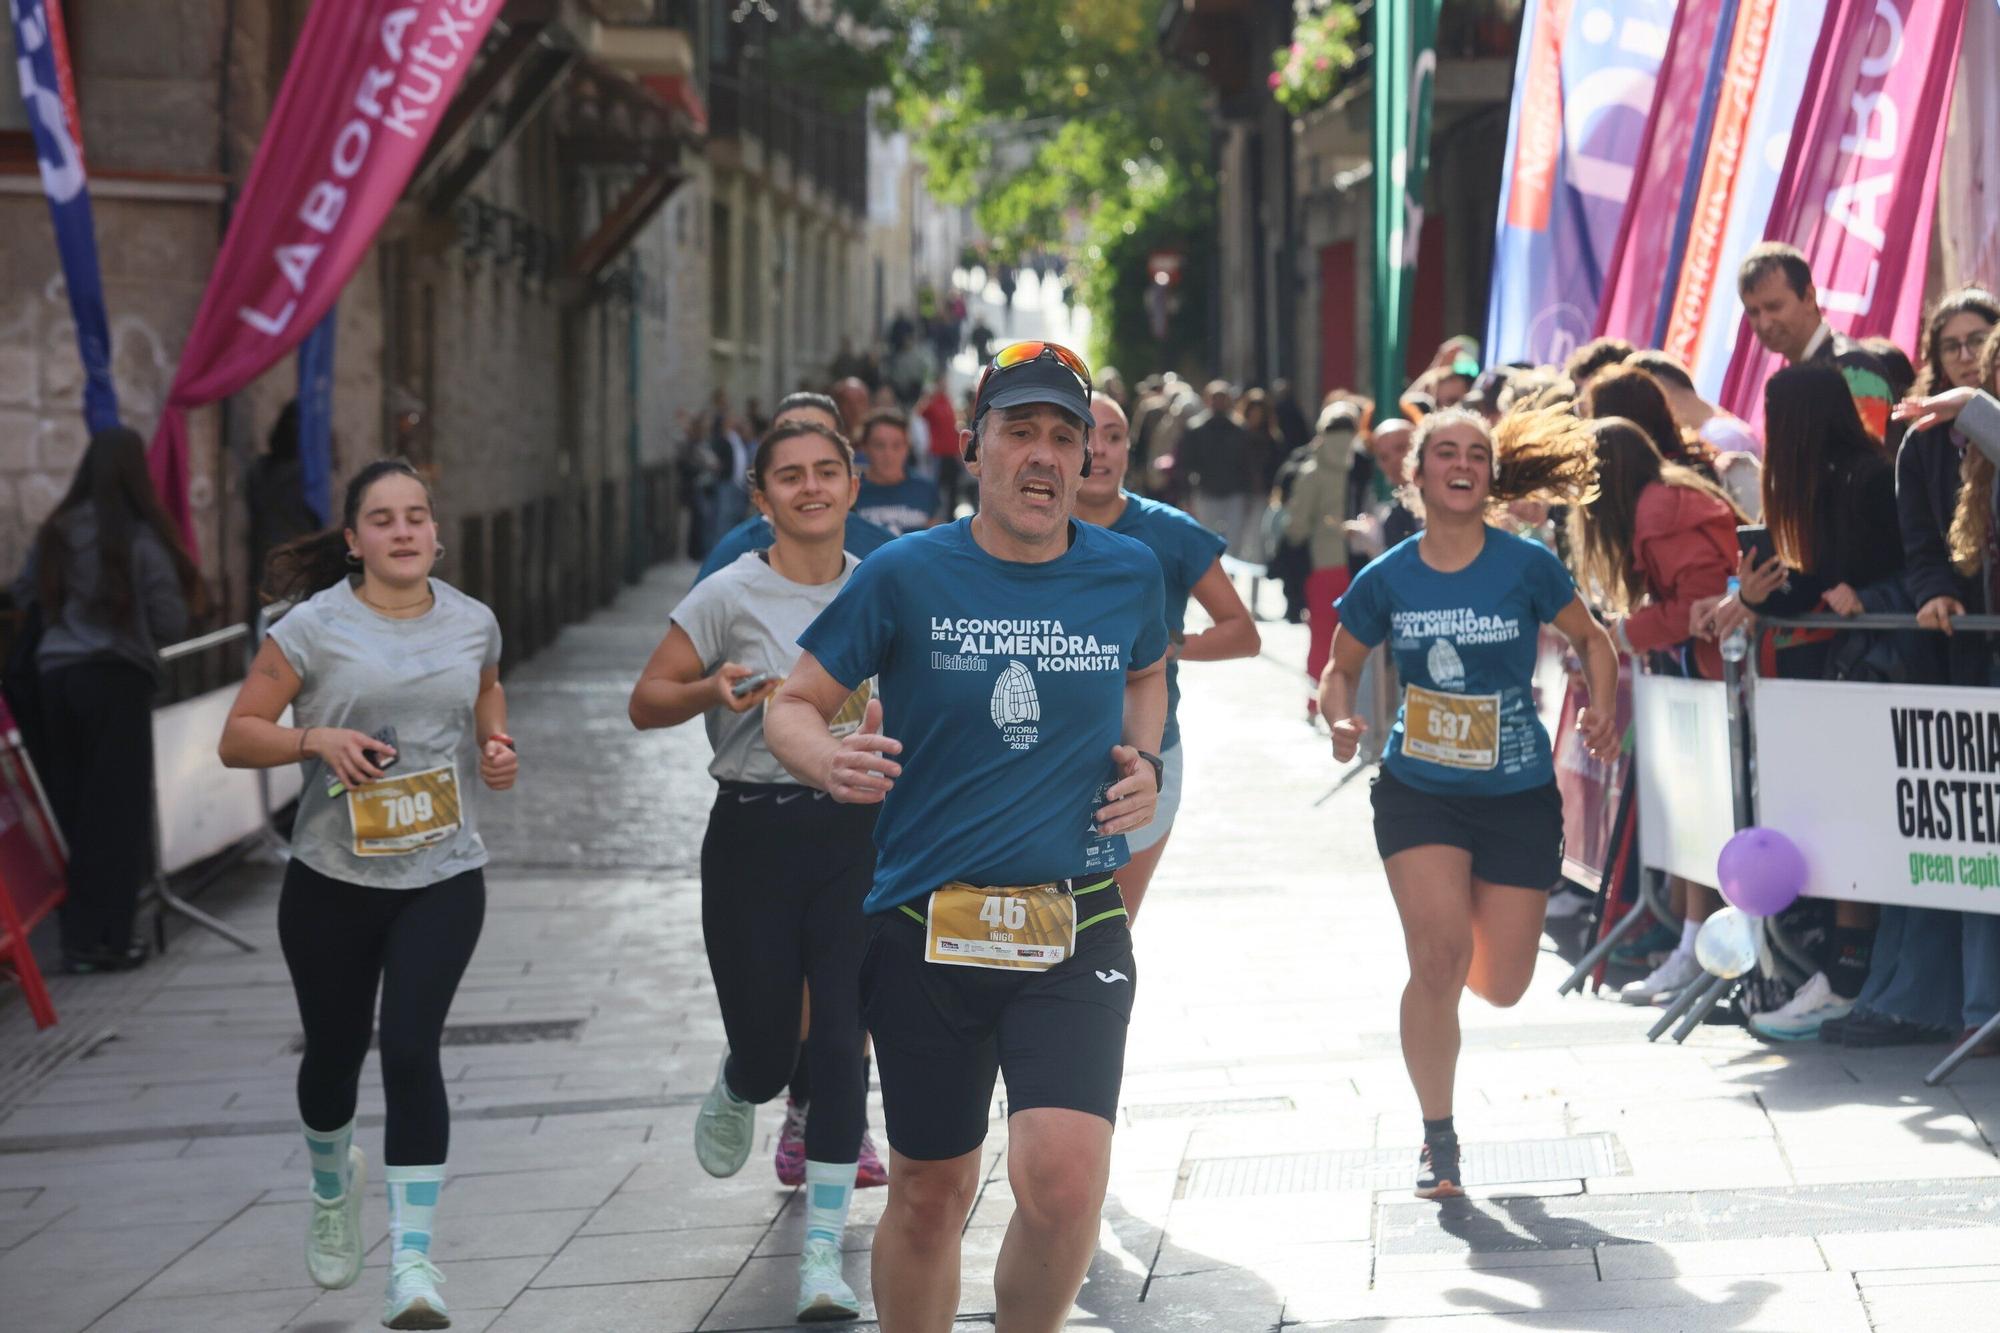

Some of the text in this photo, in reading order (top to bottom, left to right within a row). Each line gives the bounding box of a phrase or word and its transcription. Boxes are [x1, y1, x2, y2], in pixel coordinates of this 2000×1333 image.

[238, 0, 425, 336] LABORA
[931, 616, 1064, 637] LA CONQUISTA
[1401, 614, 1505, 638] ALMENDRA
[1456, 627, 1520, 645] KONKISTA
[931, 631, 1120, 655] DE LA ALMENDRA REN
[942, 654, 988, 671] Edición
[1036, 655, 1120, 672] KONKISTA
[1003, 726, 1039, 734] VITORIA
[1428, 709, 1471, 742] 537
[1002, 734, 1039, 743] GASTEIZ
[1010, 742, 1030, 750] 2025
[1890, 707, 2000, 773] VITORIA
[382, 791, 433, 829] 709
[1909, 851, 1955, 886] green
[979, 896, 1027, 930] 46
[989, 931, 1015, 942] IÑIGO
